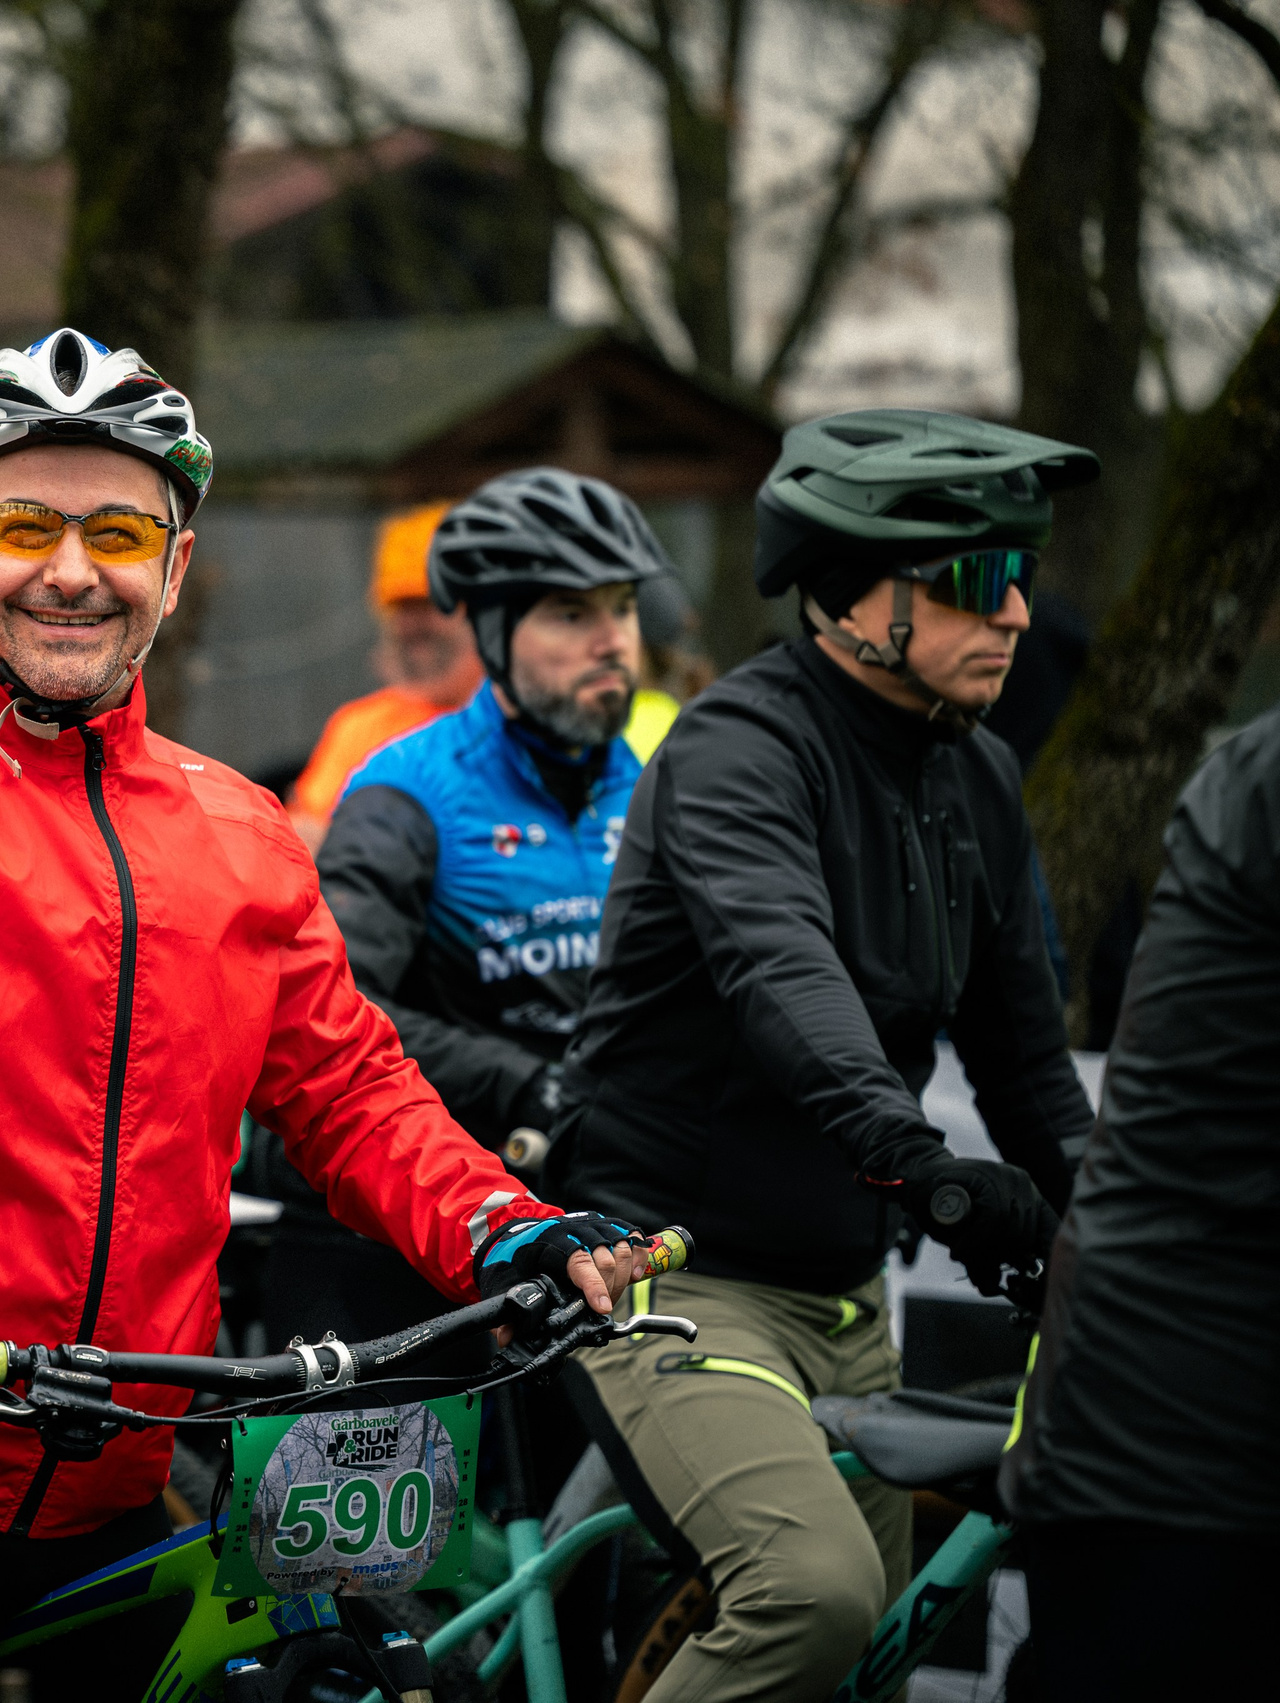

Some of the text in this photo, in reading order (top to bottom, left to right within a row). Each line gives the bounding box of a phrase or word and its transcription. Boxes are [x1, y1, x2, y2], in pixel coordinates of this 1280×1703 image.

[170, 447, 212, 467] RUD
[330, 1413, 399, 1431] Gârboavele
[344, 1438, 357, 1453] &
[352, 1427, 399, 1447] RUN
[350, 1443, 398, 1463] RIDE
[273, 1470, 432, 1558] 590
[267, 1568, 335, 1580] Powered by
[352, 1561, 399, 1574] maus
